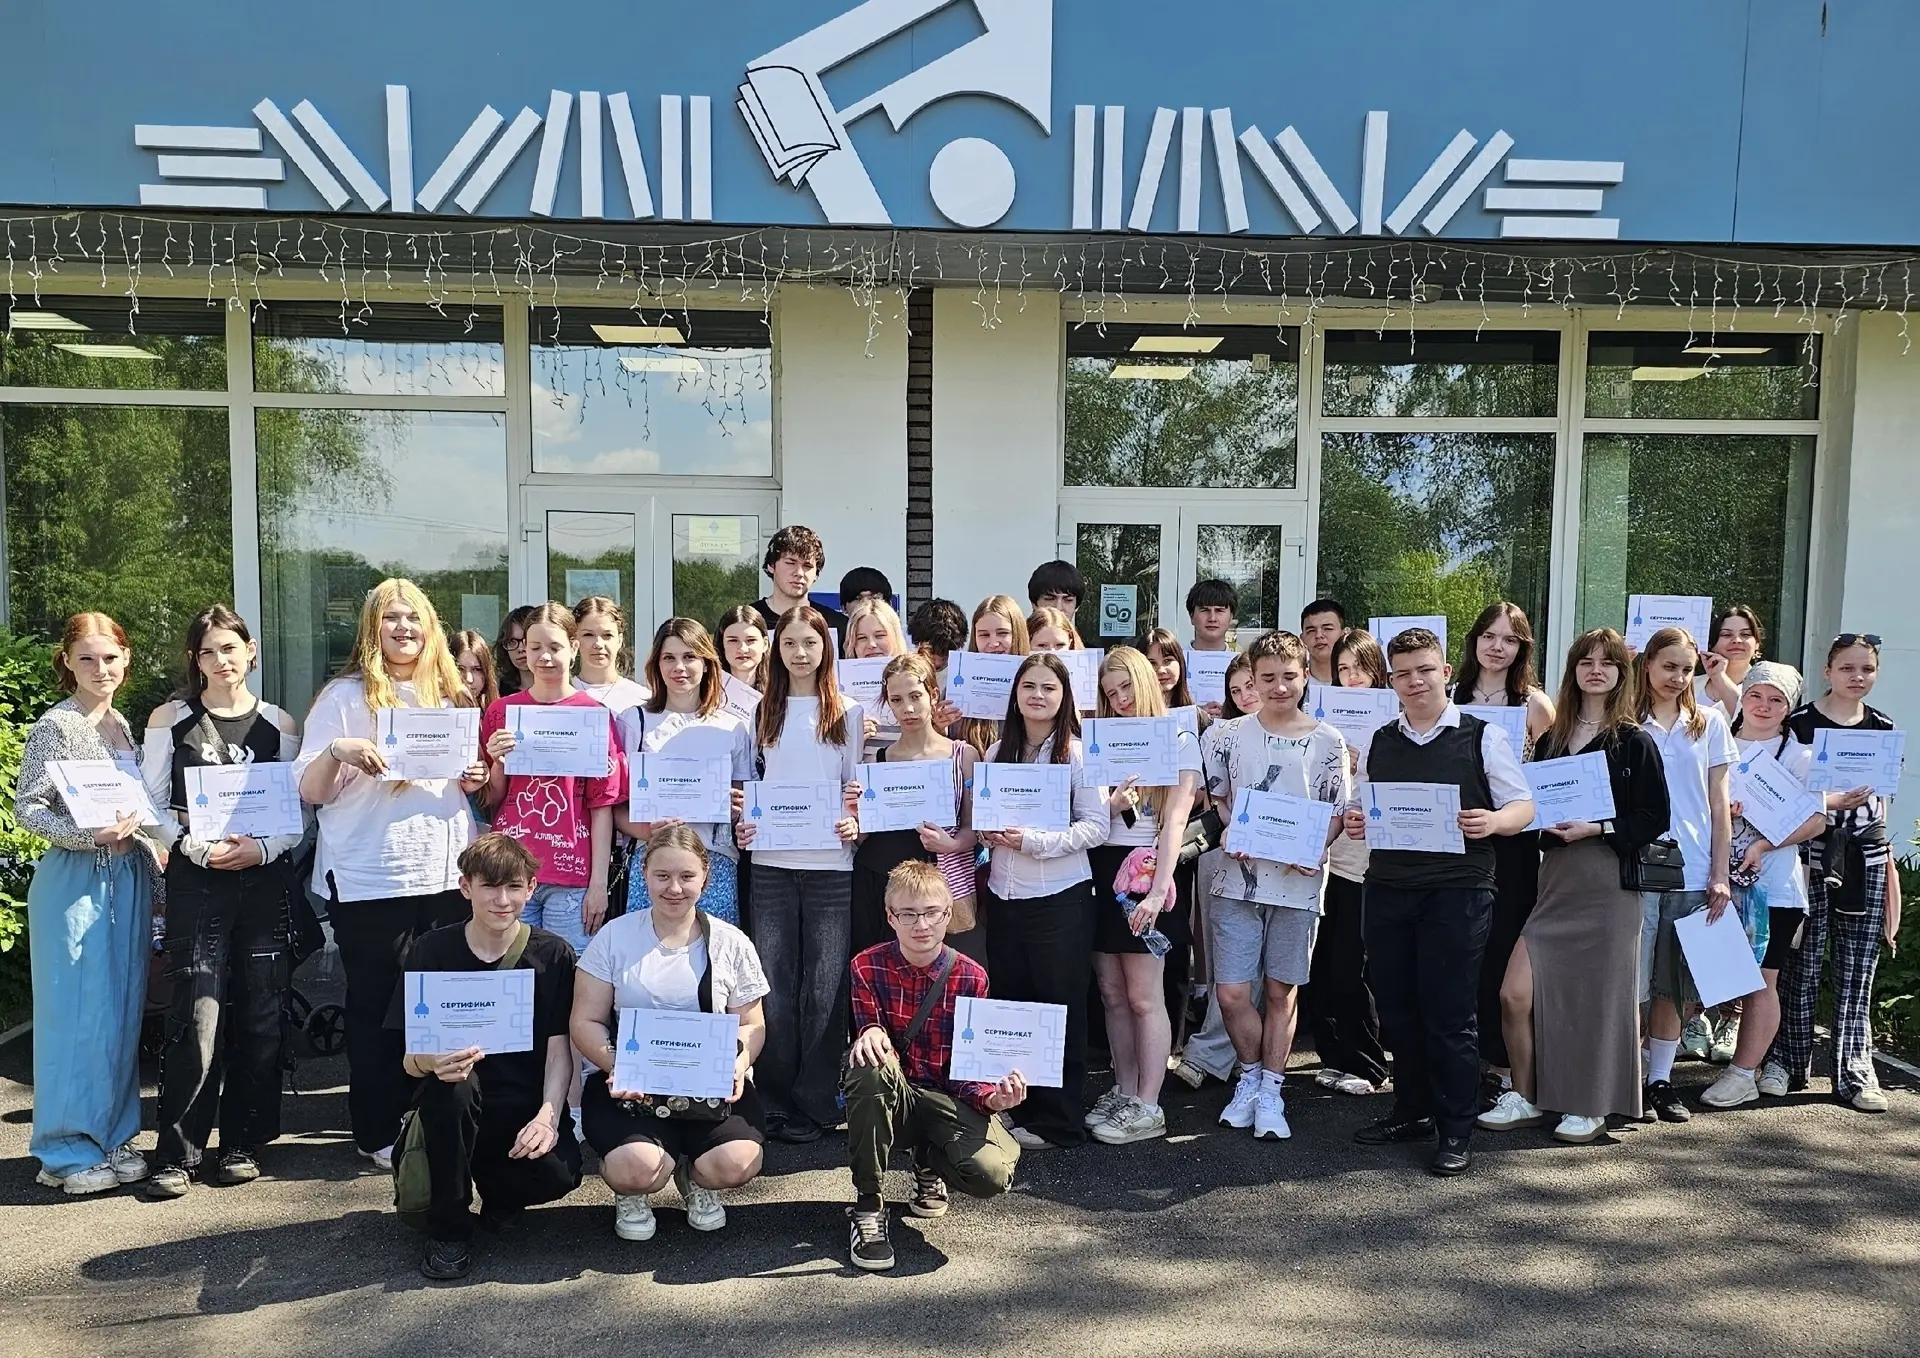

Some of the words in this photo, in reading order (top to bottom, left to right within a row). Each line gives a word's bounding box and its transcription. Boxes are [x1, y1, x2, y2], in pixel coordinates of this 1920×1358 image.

[440, 1001, 497, 1009] СЕРТИФИКАТ
[984, 1028, 1033, 1038] СЕРТИФИКАТ
[650, 1039, 702, 1049] СЕРТИФИКАТ
